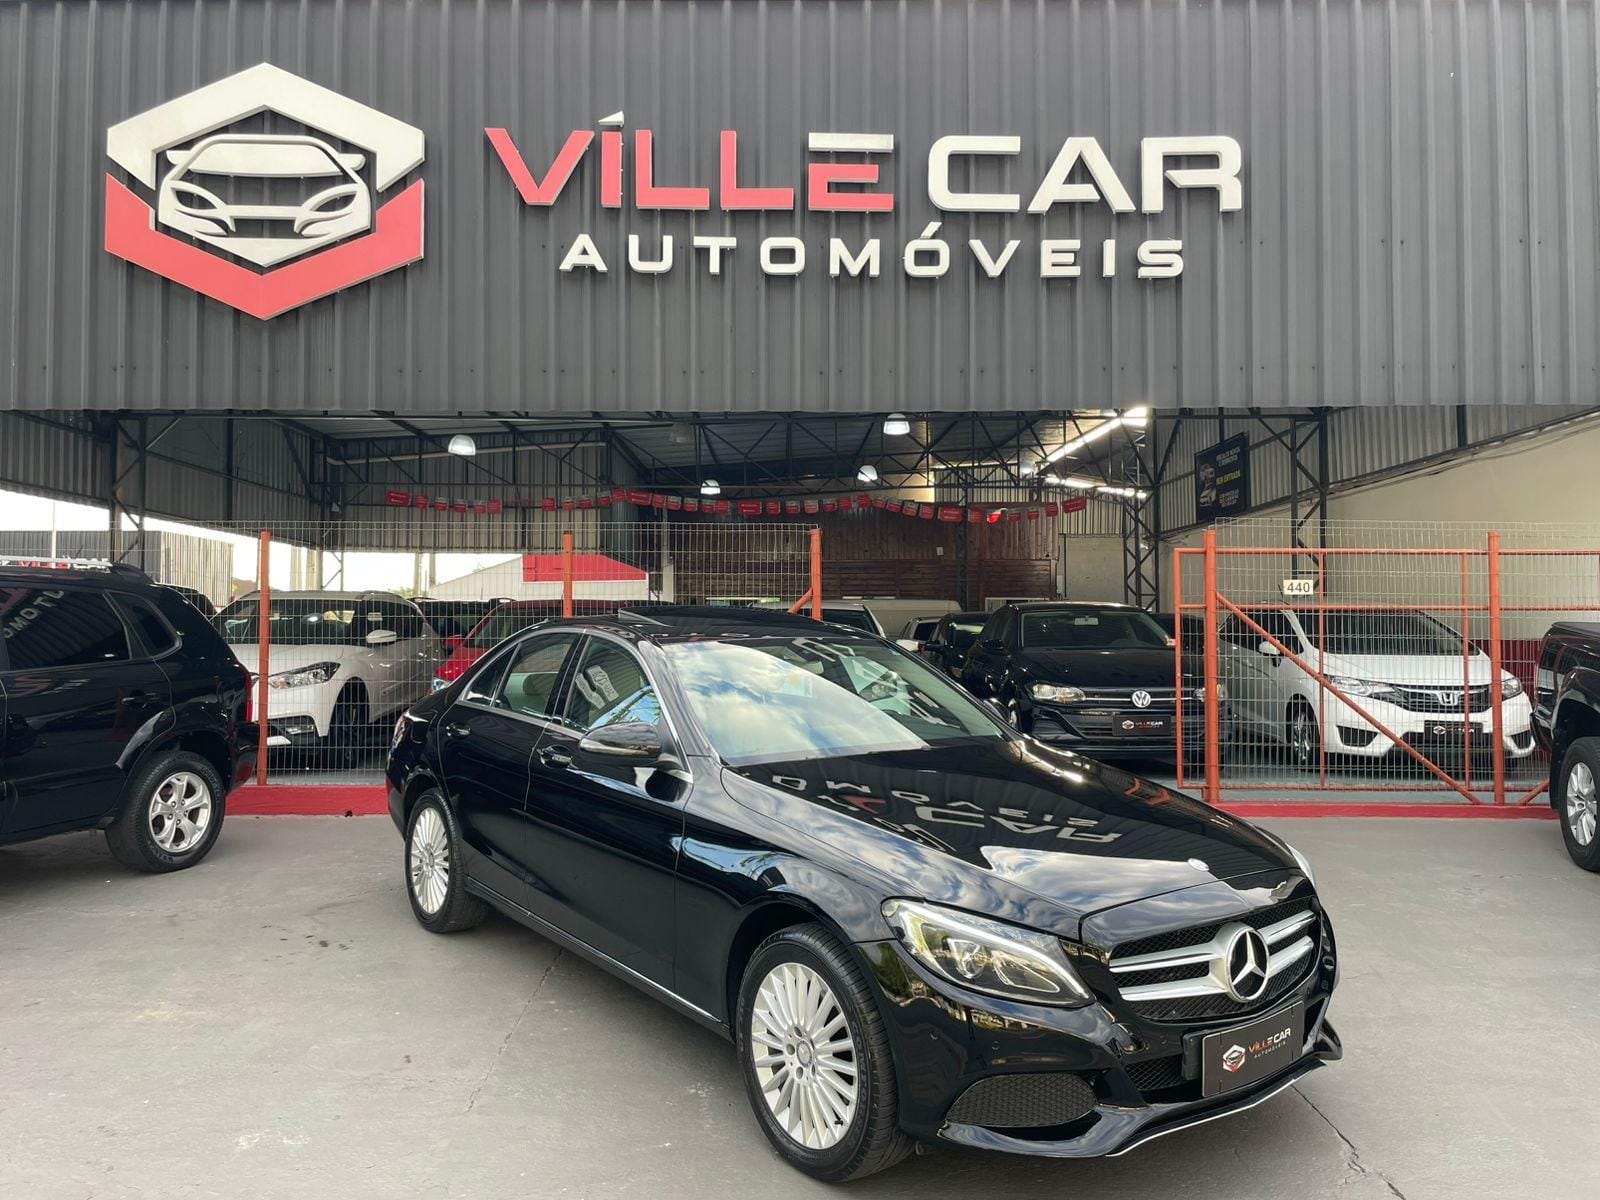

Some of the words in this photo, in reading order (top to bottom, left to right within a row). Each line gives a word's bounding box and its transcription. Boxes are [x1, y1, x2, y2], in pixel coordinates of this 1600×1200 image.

[928, 135, 1244, 214] CAR
[559, 222, 1184, 279] AUTOMÓVEIS
[1287, 582, 1310, 593] 440
